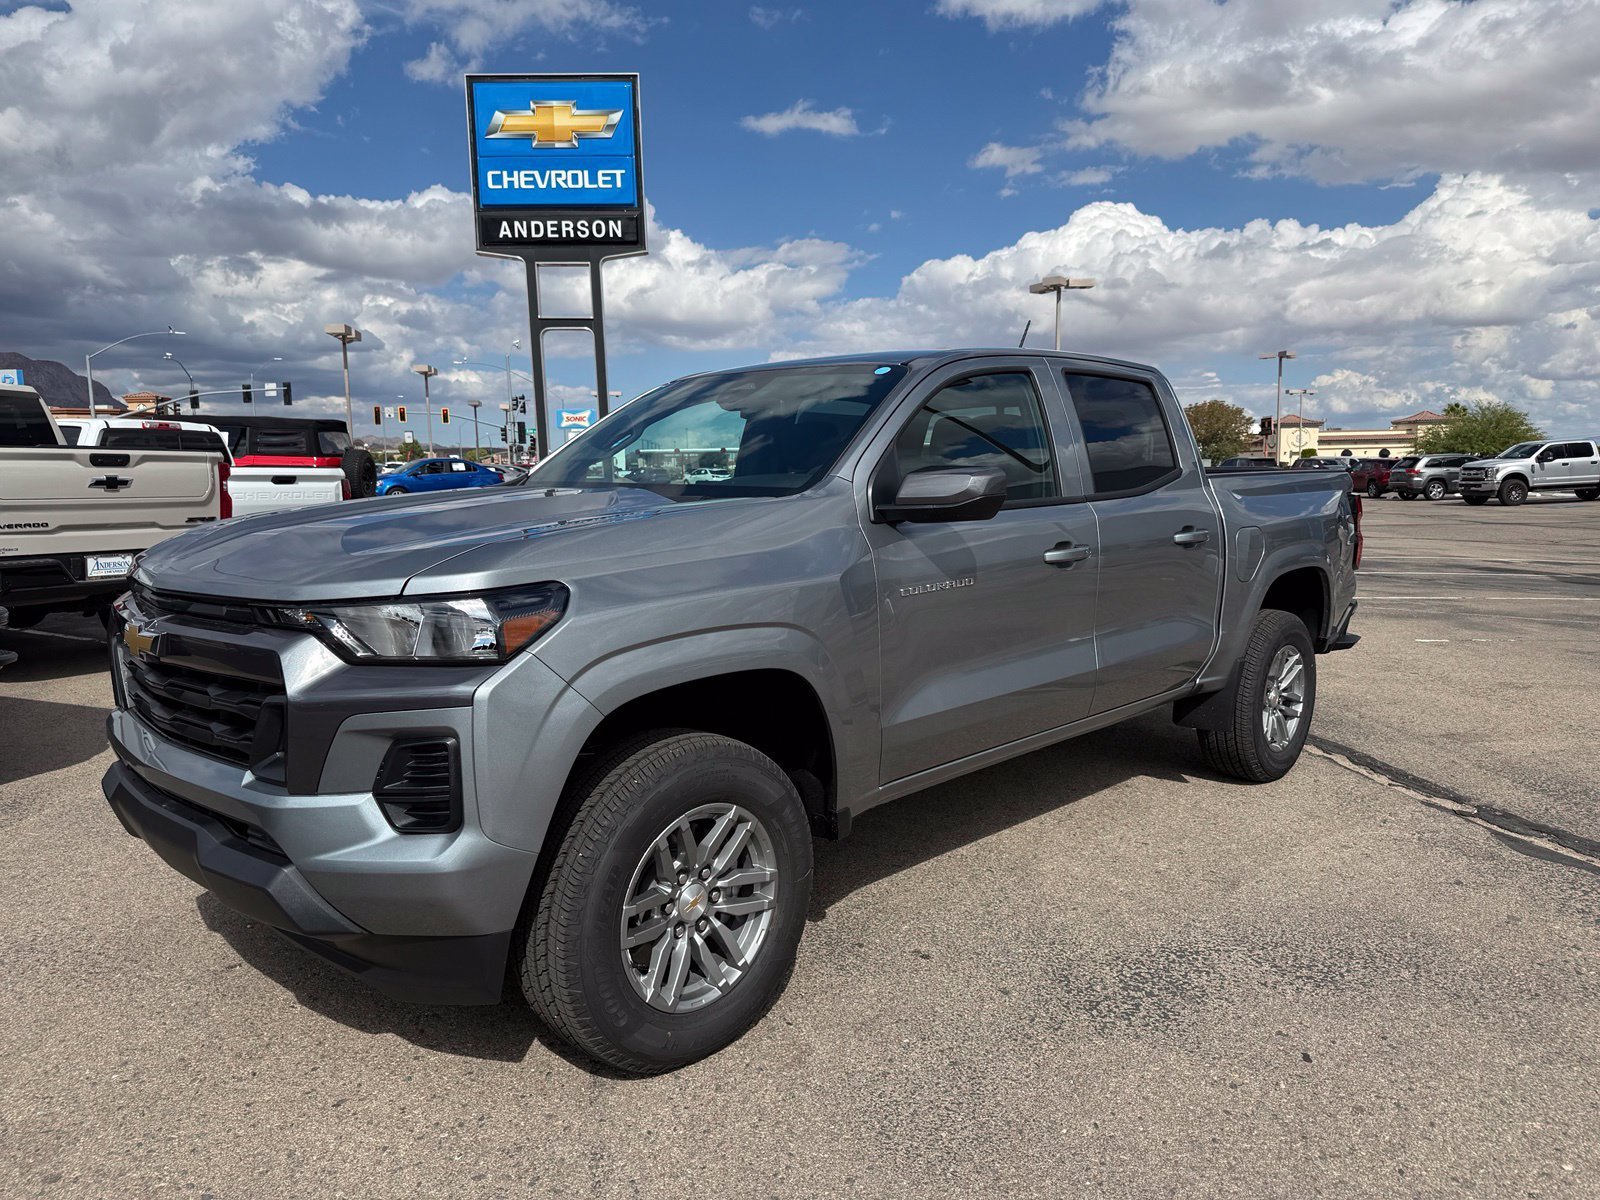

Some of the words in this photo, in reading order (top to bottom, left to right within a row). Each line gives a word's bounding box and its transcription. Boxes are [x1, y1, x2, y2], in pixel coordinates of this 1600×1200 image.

[487, 169, 626, 189] CHEVROLET
[499, 219, 622, 238] ANDERSON
[231, 490, 333, 501] CHEVROLET
[90, 560, 130, 575] ANDERSON
[900, 577, 974, 597] COLORADO
